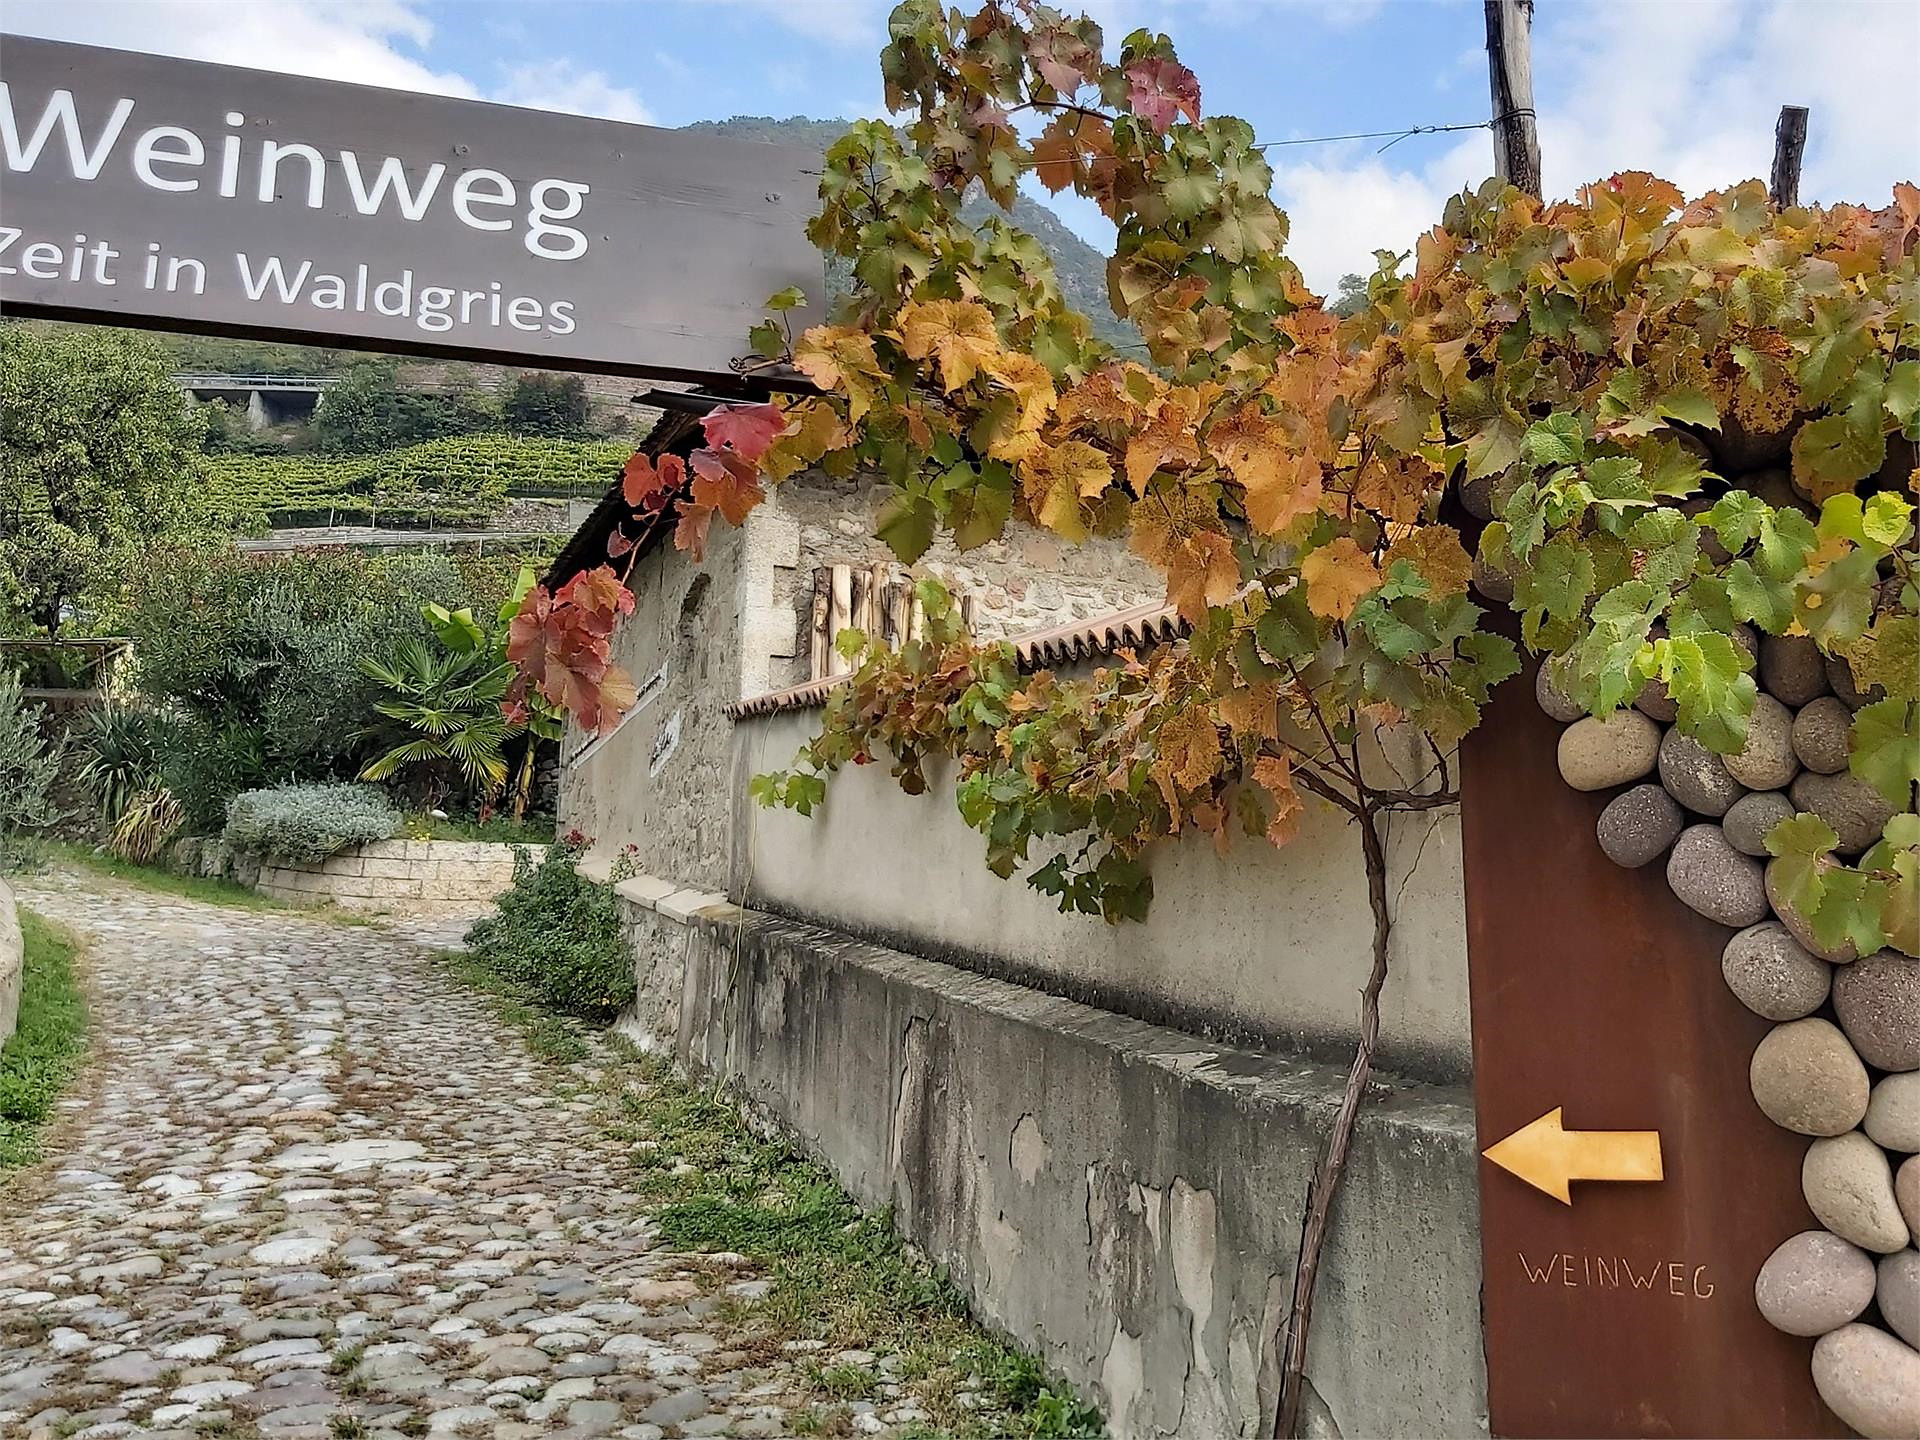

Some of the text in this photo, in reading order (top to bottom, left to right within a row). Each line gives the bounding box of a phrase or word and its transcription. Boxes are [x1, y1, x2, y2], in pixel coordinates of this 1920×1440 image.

[0, 80, 591, 261] Weinweg
[0, 226, 577, 335] Zeit in Waldgries
[1518, 1252, 1714, 1299] WEINWEG
